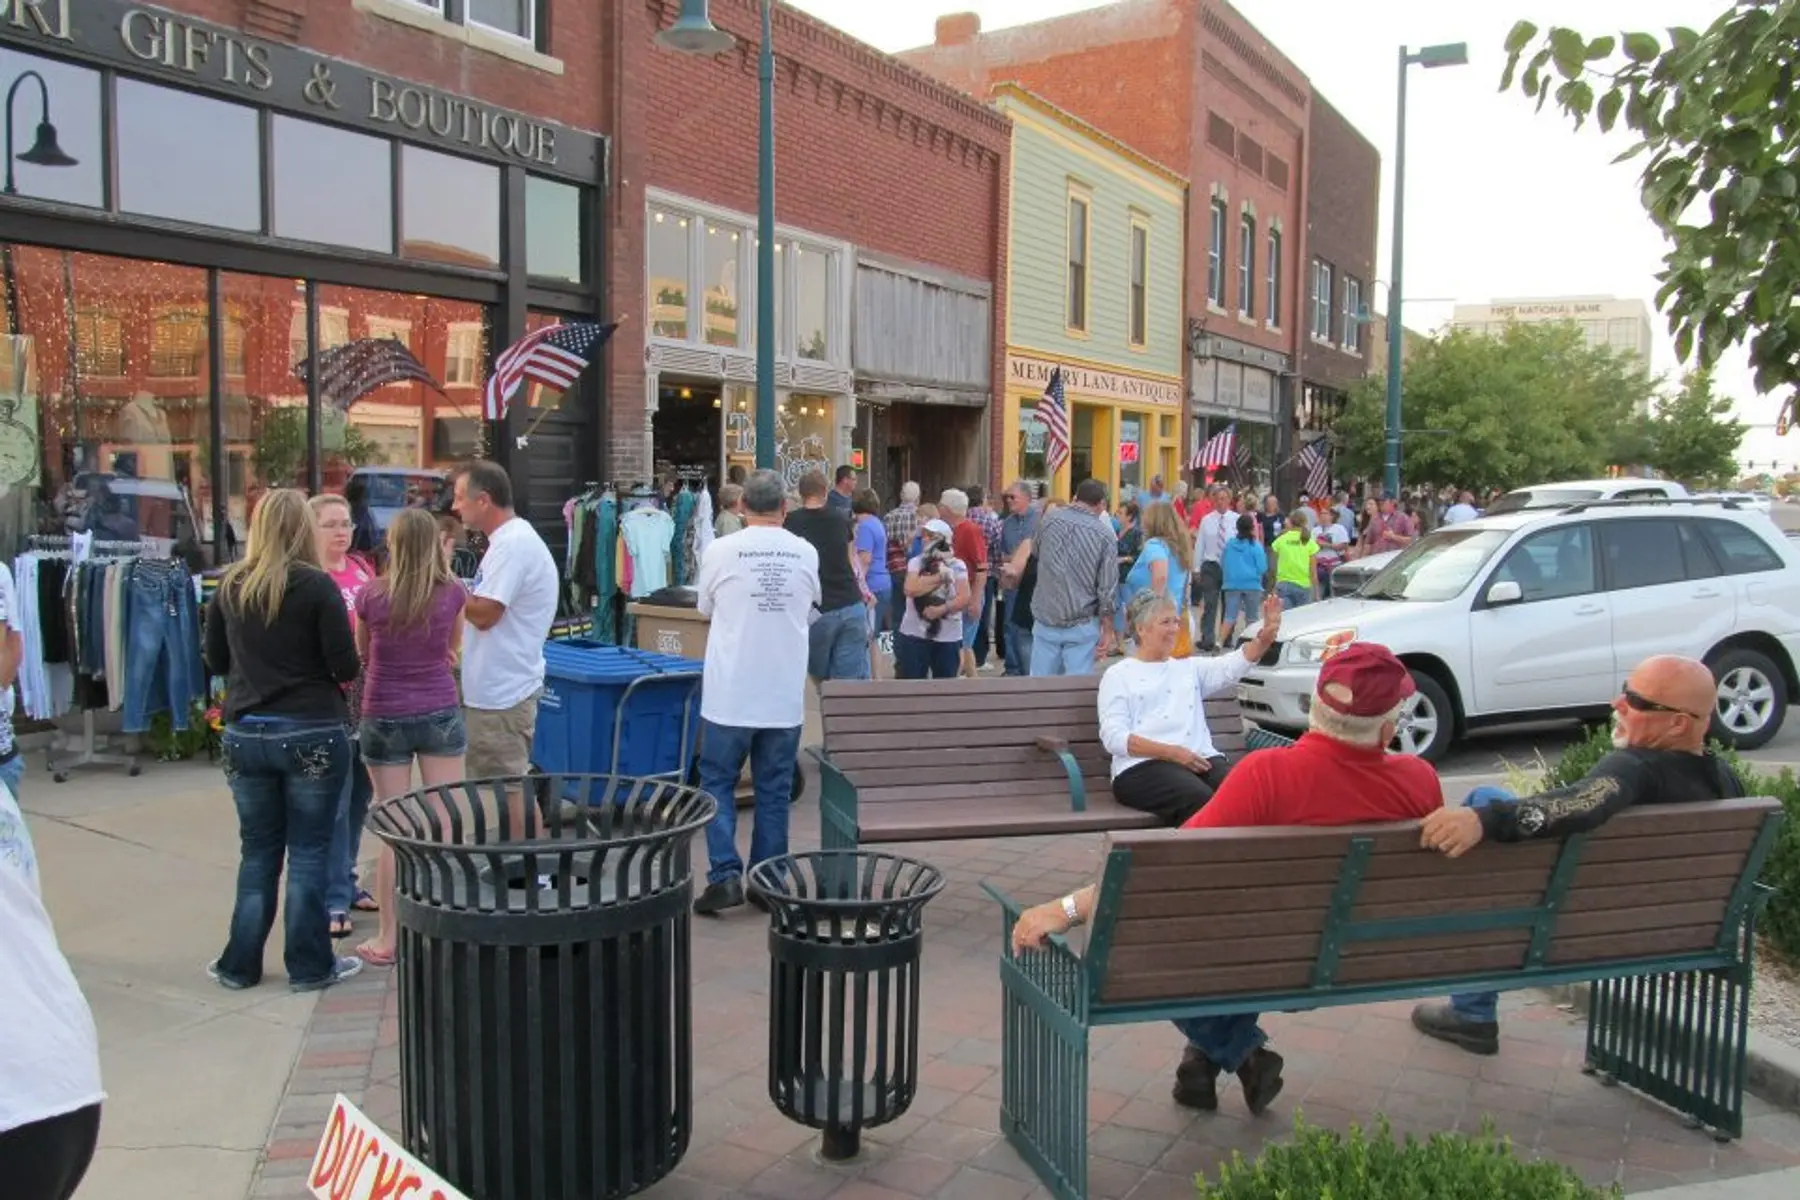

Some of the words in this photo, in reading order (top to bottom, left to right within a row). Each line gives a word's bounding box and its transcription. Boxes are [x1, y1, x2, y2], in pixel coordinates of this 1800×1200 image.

[120, 9, 274, 90] GIFTS
[303, 61, 340, 110] &
[369, 77, 558, 165] BOUTIQUE
[1518, 304, 1570, 314] NATIONAL
[1574, 303, 1601, 313] BANK
[1083, 373, 1119, 391] LANE
[1121, 379, 1180, 402] ANTIQUES
